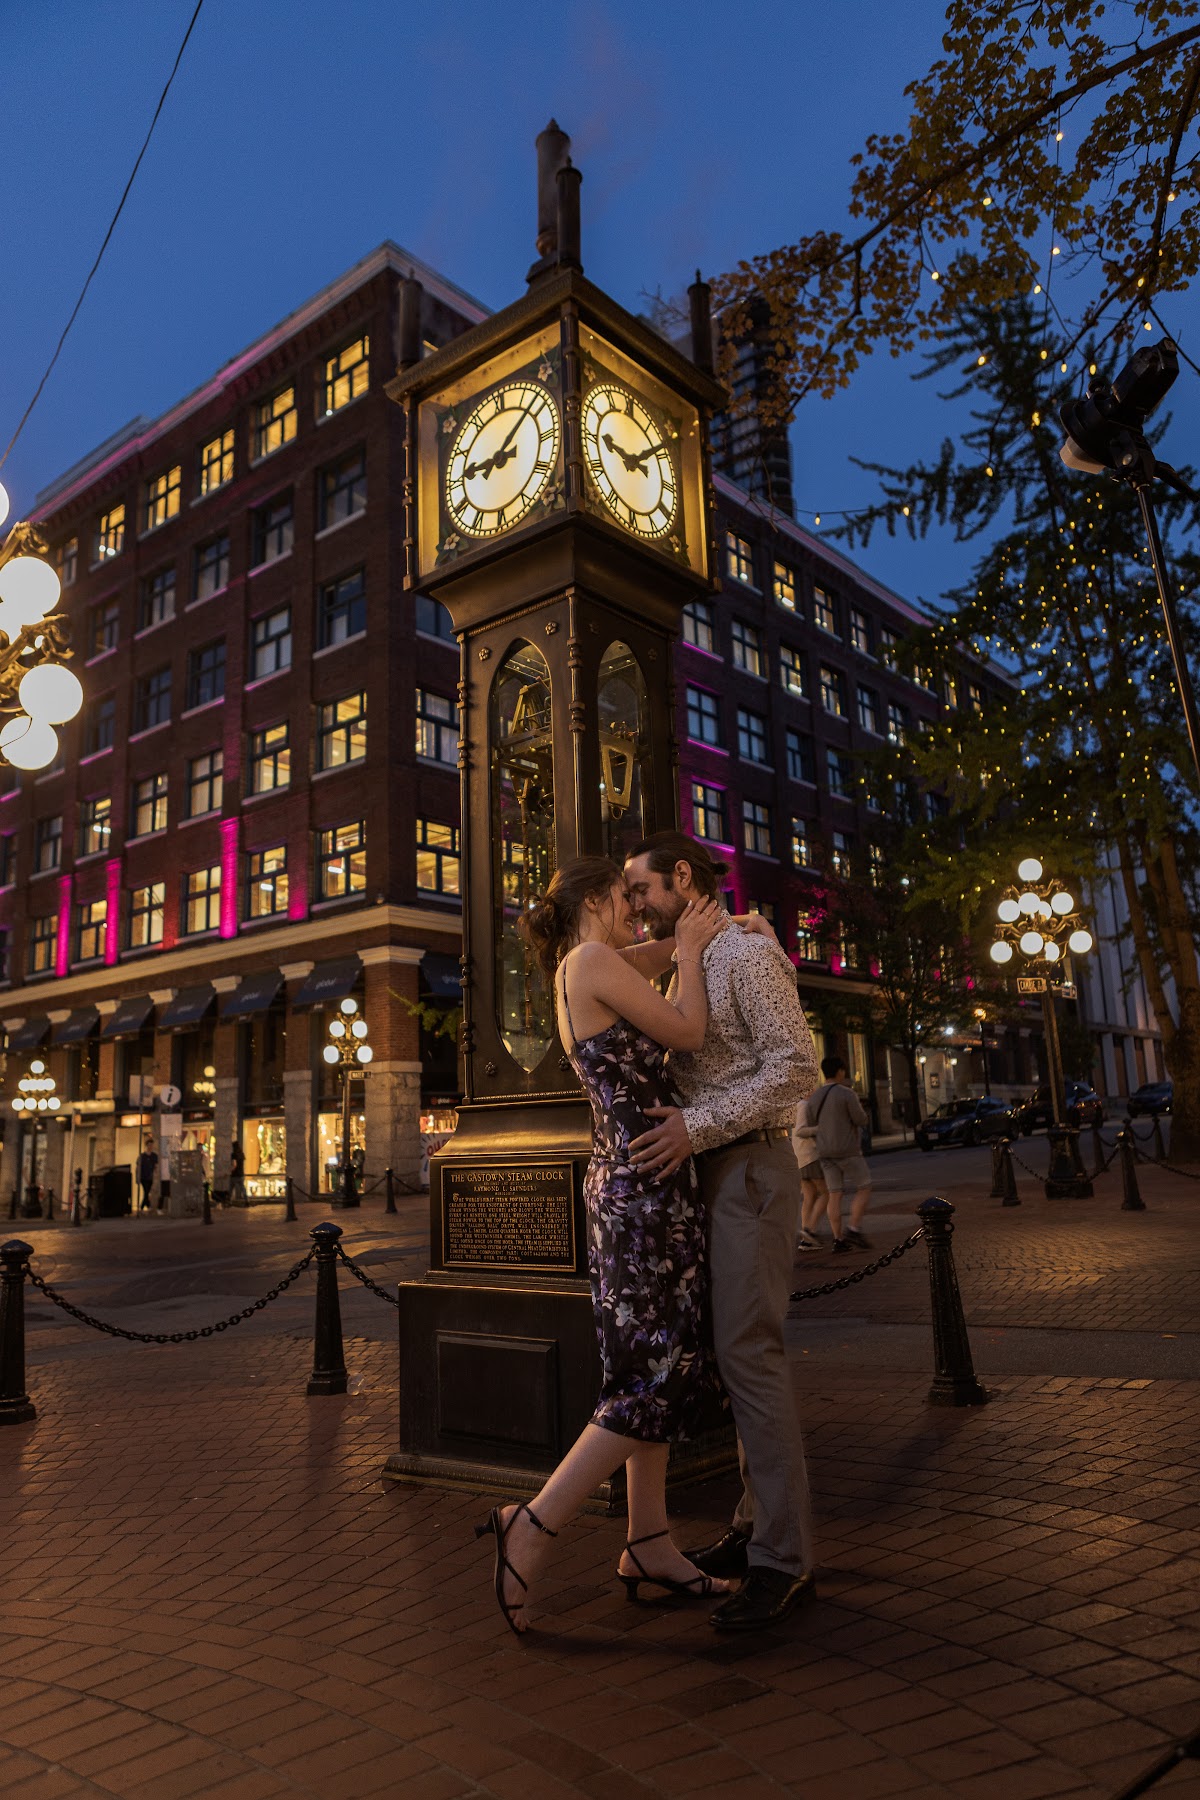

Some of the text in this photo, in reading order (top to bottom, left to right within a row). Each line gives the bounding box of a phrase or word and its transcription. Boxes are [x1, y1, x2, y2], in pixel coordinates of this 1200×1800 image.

[451, 1171, 564, 1183] THE GASTOWN STEAM CLOCK
